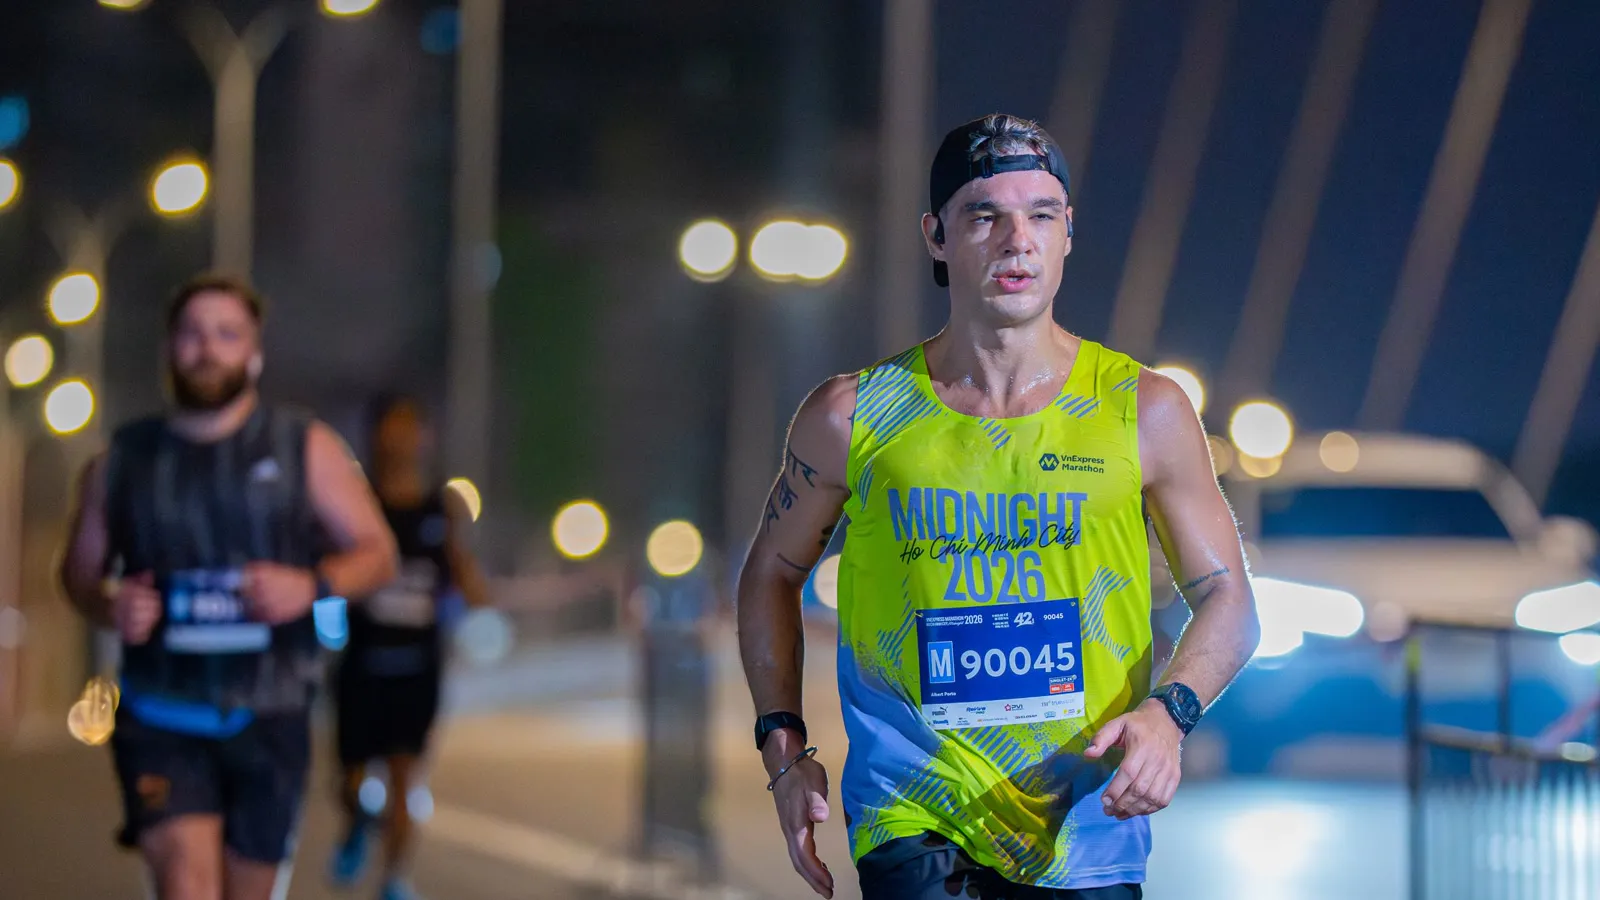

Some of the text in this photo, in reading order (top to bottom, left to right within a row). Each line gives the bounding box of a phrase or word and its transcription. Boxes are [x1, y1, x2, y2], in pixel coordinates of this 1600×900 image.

[1061, 455, 1104, 465] VnExpress
[1062, 464, 1104, 474] Marathon
[887, 487, 1088, 546] MIDNIGHT
[900, 522, 1080, 564] Ho Chi Minh City
[938, 547, 1046, 603] 2026
[965, 614, 983, 625] 2026
[1043, 612, 1064, 620] 90045
[930, 648, 952, 678] M
[960, 641, 1076, 680] 90045
